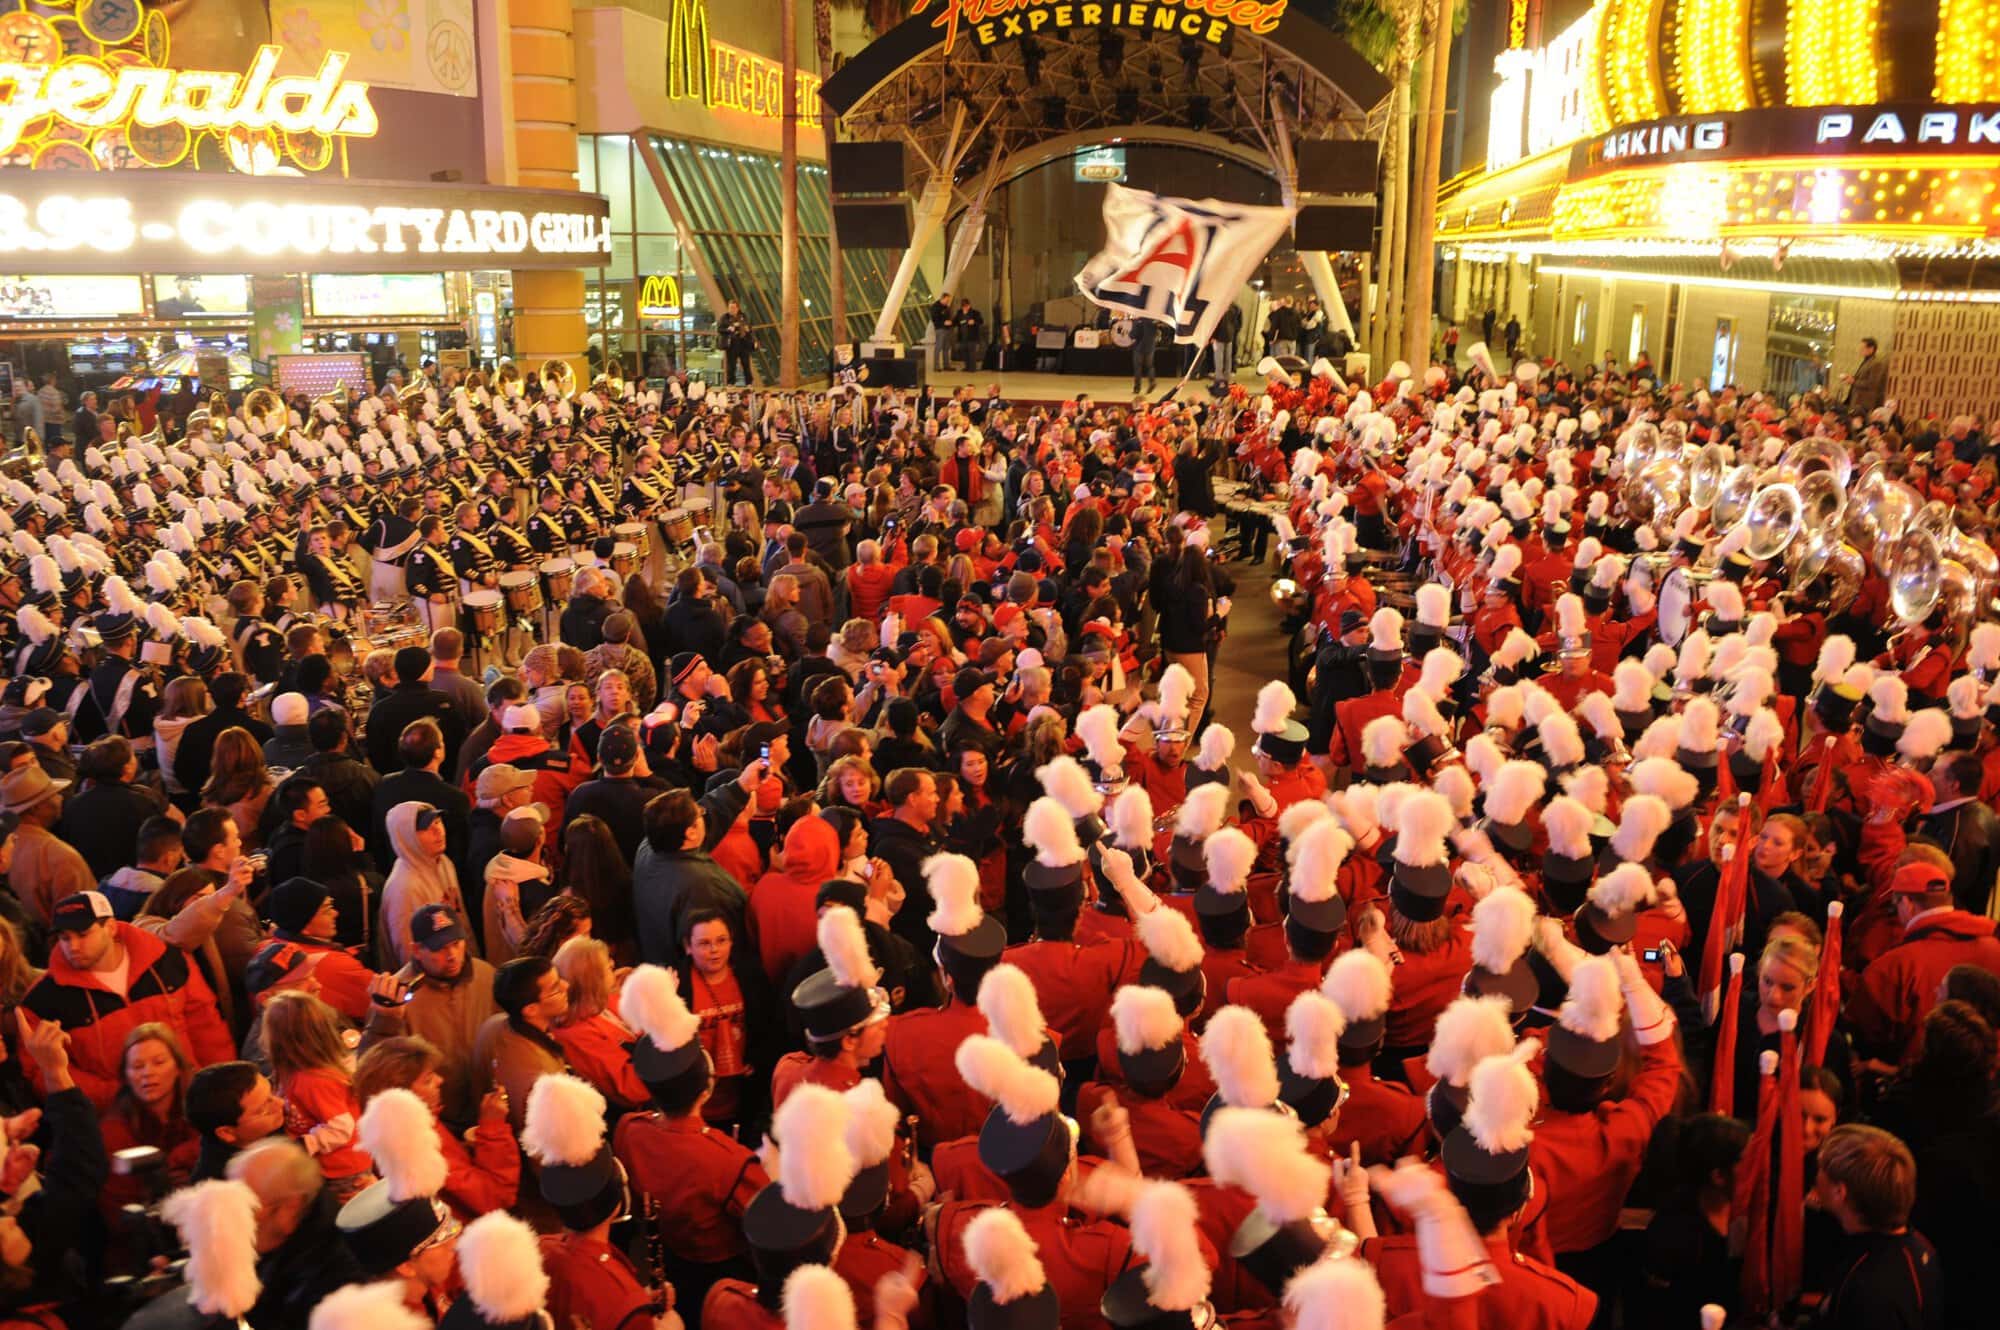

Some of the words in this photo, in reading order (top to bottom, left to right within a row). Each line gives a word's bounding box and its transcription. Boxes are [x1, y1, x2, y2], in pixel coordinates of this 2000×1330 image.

[977, 3, 1228, 45] EXPERIENCE
[1816, 111, 2000, 144] PARK
[178, 197, 528, 253] COURTYARD
